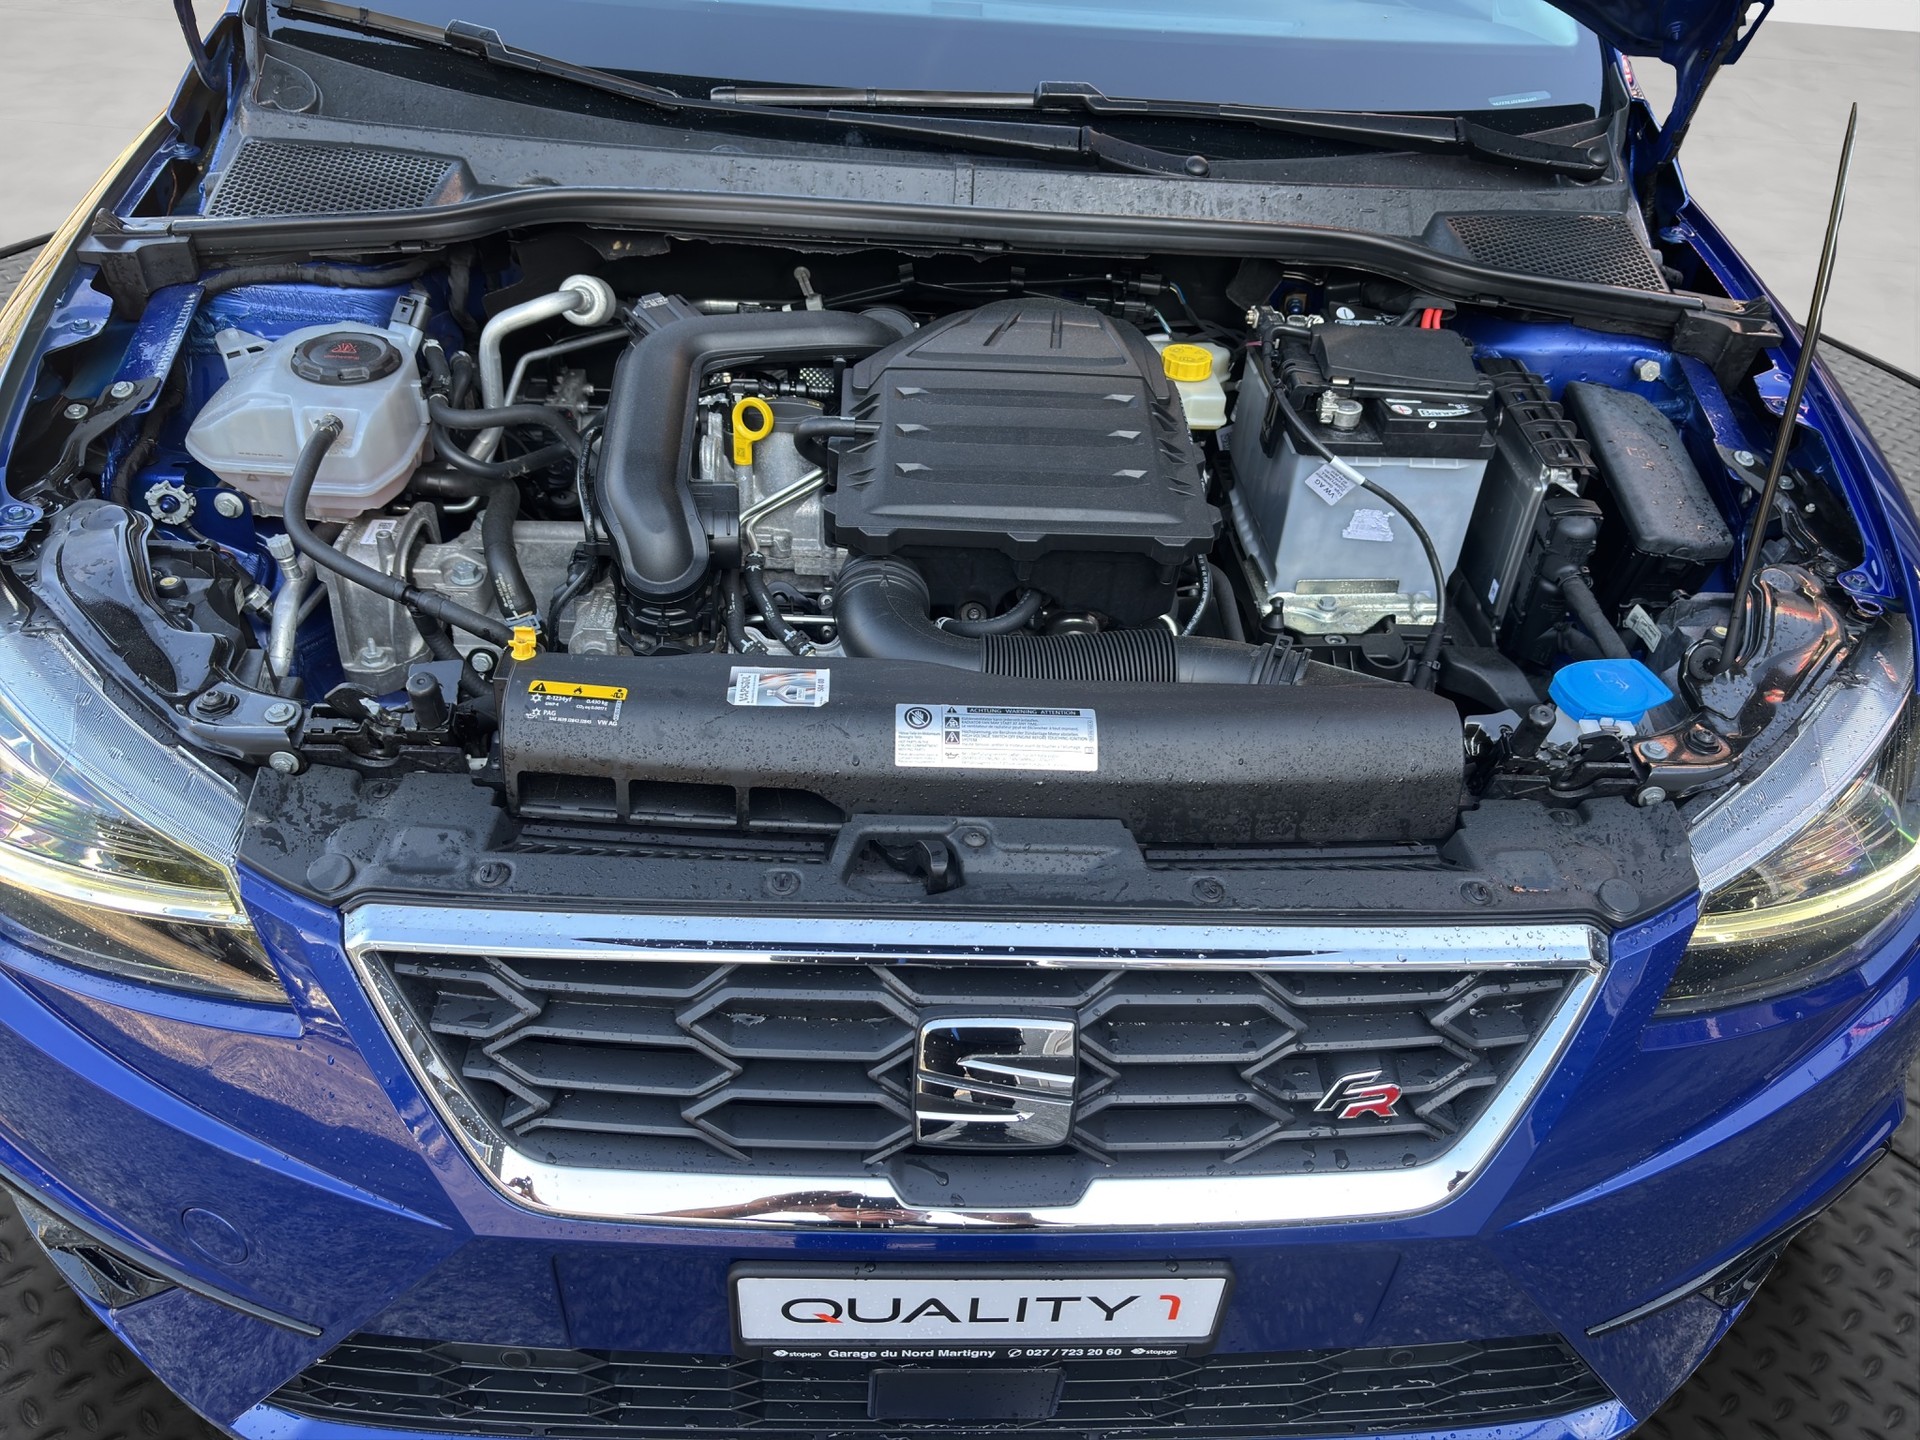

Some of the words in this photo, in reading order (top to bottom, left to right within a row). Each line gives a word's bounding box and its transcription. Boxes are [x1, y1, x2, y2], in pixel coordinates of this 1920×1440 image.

[1314, 479, 1324, 488] AG
[1324, 487, 1335, 498] VW
[1313, 1069, 1403, 1120] FR
[781, 1295, 1142, 1324] QUALITY
[1159, 1294, 1182, 1321] 1
[828, 1350, 877, 1359] Garage
[880, 1350, 892, 1358] du
[901, 1350, 934, 1358] Nord
[938, 1348, 996, 1358] Martigny
